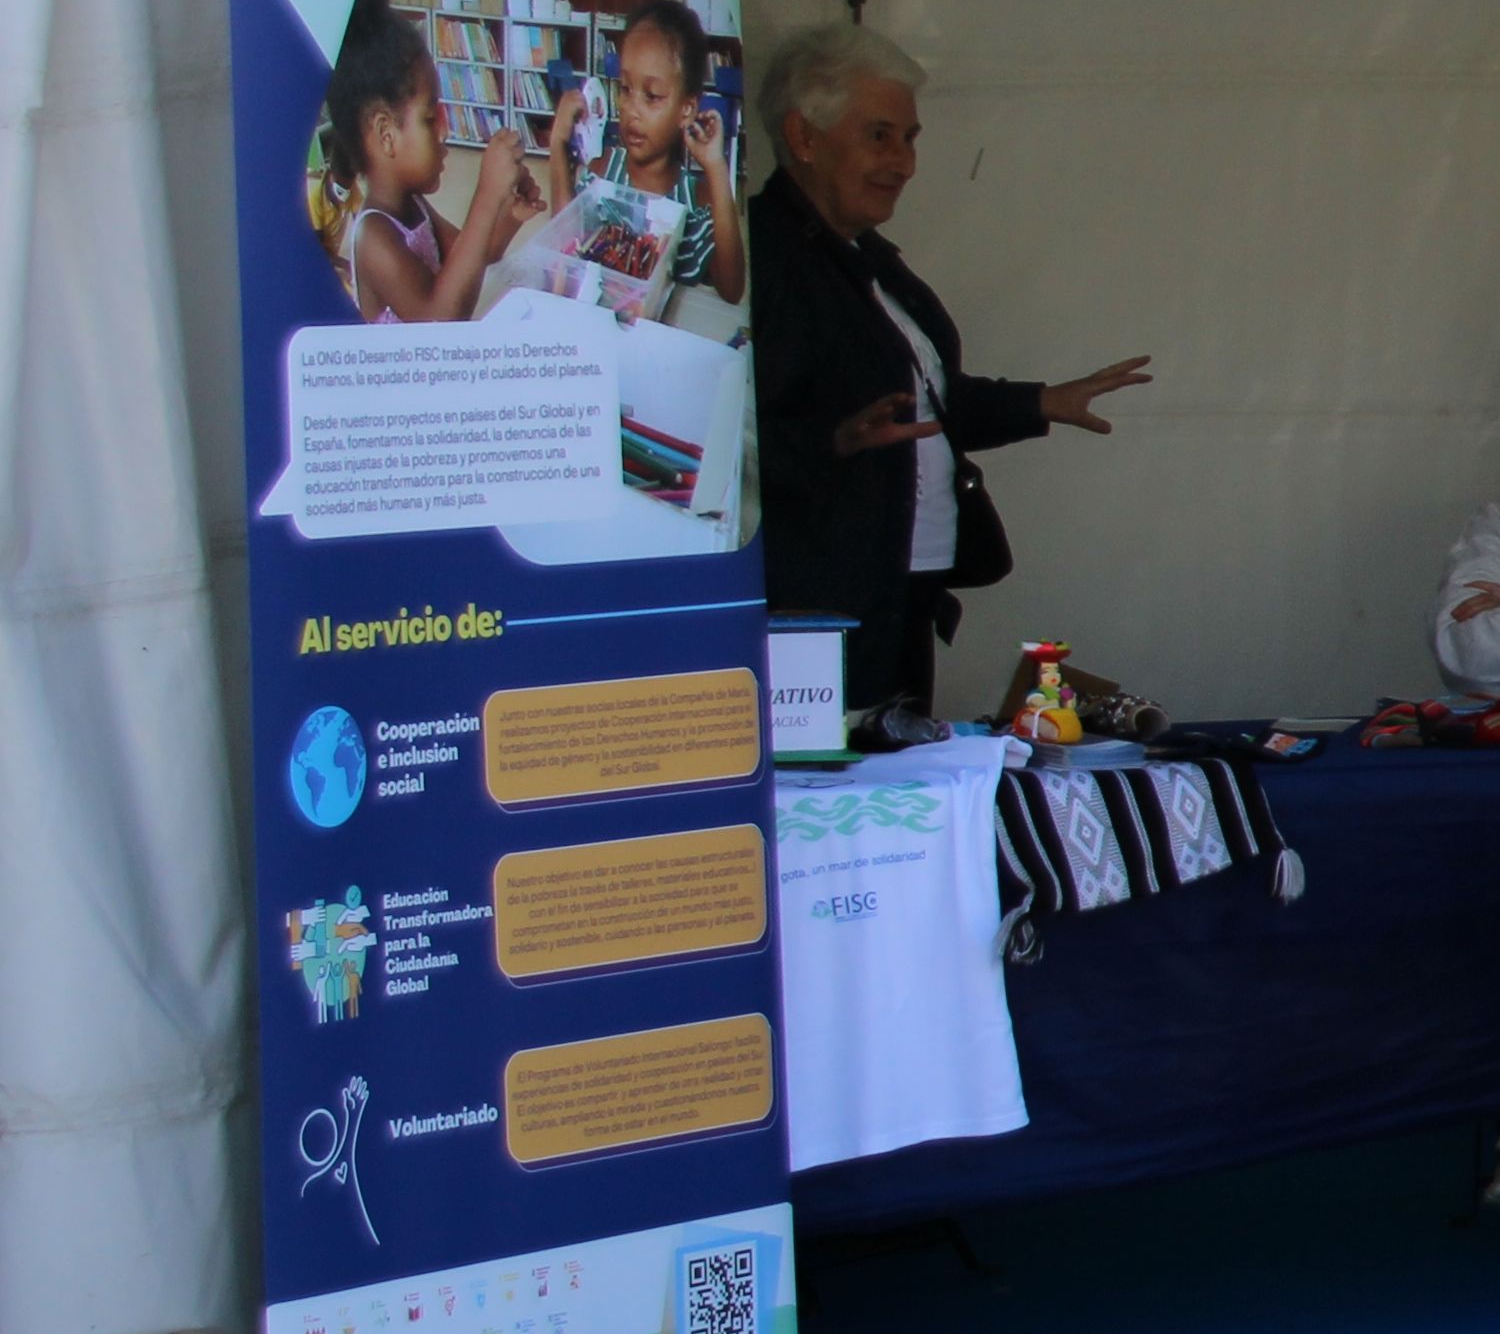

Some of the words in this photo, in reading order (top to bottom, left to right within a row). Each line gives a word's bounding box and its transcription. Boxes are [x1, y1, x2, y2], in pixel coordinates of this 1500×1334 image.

[316, 352, 342, 365] ONG
[344, 351, 357, 364] de
[358, 349, 413, 364] Desarrollo
[414, 348, 440, 362] FISC
[441, 347, 480, 364] trabaja
[482, 349, 502, 363] por
[503, 345, 520, 358] los
[522, 343, 577, 358] Derechos
[367, 371, 410, 388] equidad
[412, 370, 427, 383] de
[429, 368, 467, 386] género
[490, 365, 536, 380] cuidado
[303, 416, 338, 431] Desde
[341, 414, 386, 429] nuestros
[387, 411, 442, 430] proyectos
[443, 413, 458, 423] en
[498, 407, 515, 421] del
[517, 406, 538, 420] Sur
[538, 404, 575, 419] Global
[347, 433, 413, 449] fomentamos
[504, 426, 556, 441] denuncia
[304, 461, 342, 473] causas
[412, 452, 458, 470] pobreza
[305, 478, 360, 494] educación
[447, 475, 473, 489] para
[487, 466, 561, 483] construcción
[306, 500, 356, 516] sociedad
[299, 616, 332, 655] Al
[336, 605, 449, 652] servicio
[457, 603, 504, 640] de:
[376, 714, 480, 747] Cooperación
[377, 755, 388, 770] e
[389, 742, 459, 768] inclusión
[378, 772, 425, 797] social
[813, 865, 826, 876] un
[828, 861, 852, 872] mar
[854, 857, 869, 869] de
[872, 850, 927, 866] solidaridad
[382, 887, 449, 910] Educación
[831, 891, 878, 916] FISC
[383, 903, 494, 931] Transformadora
[384, 937, 416, 956] para
[417, 932, 430, 948] la
[385, 950, 459, 975] Ciudadanía
[386, 975, 429, 996] Global
[389, 1103, 498, 1140] Voluntariado
